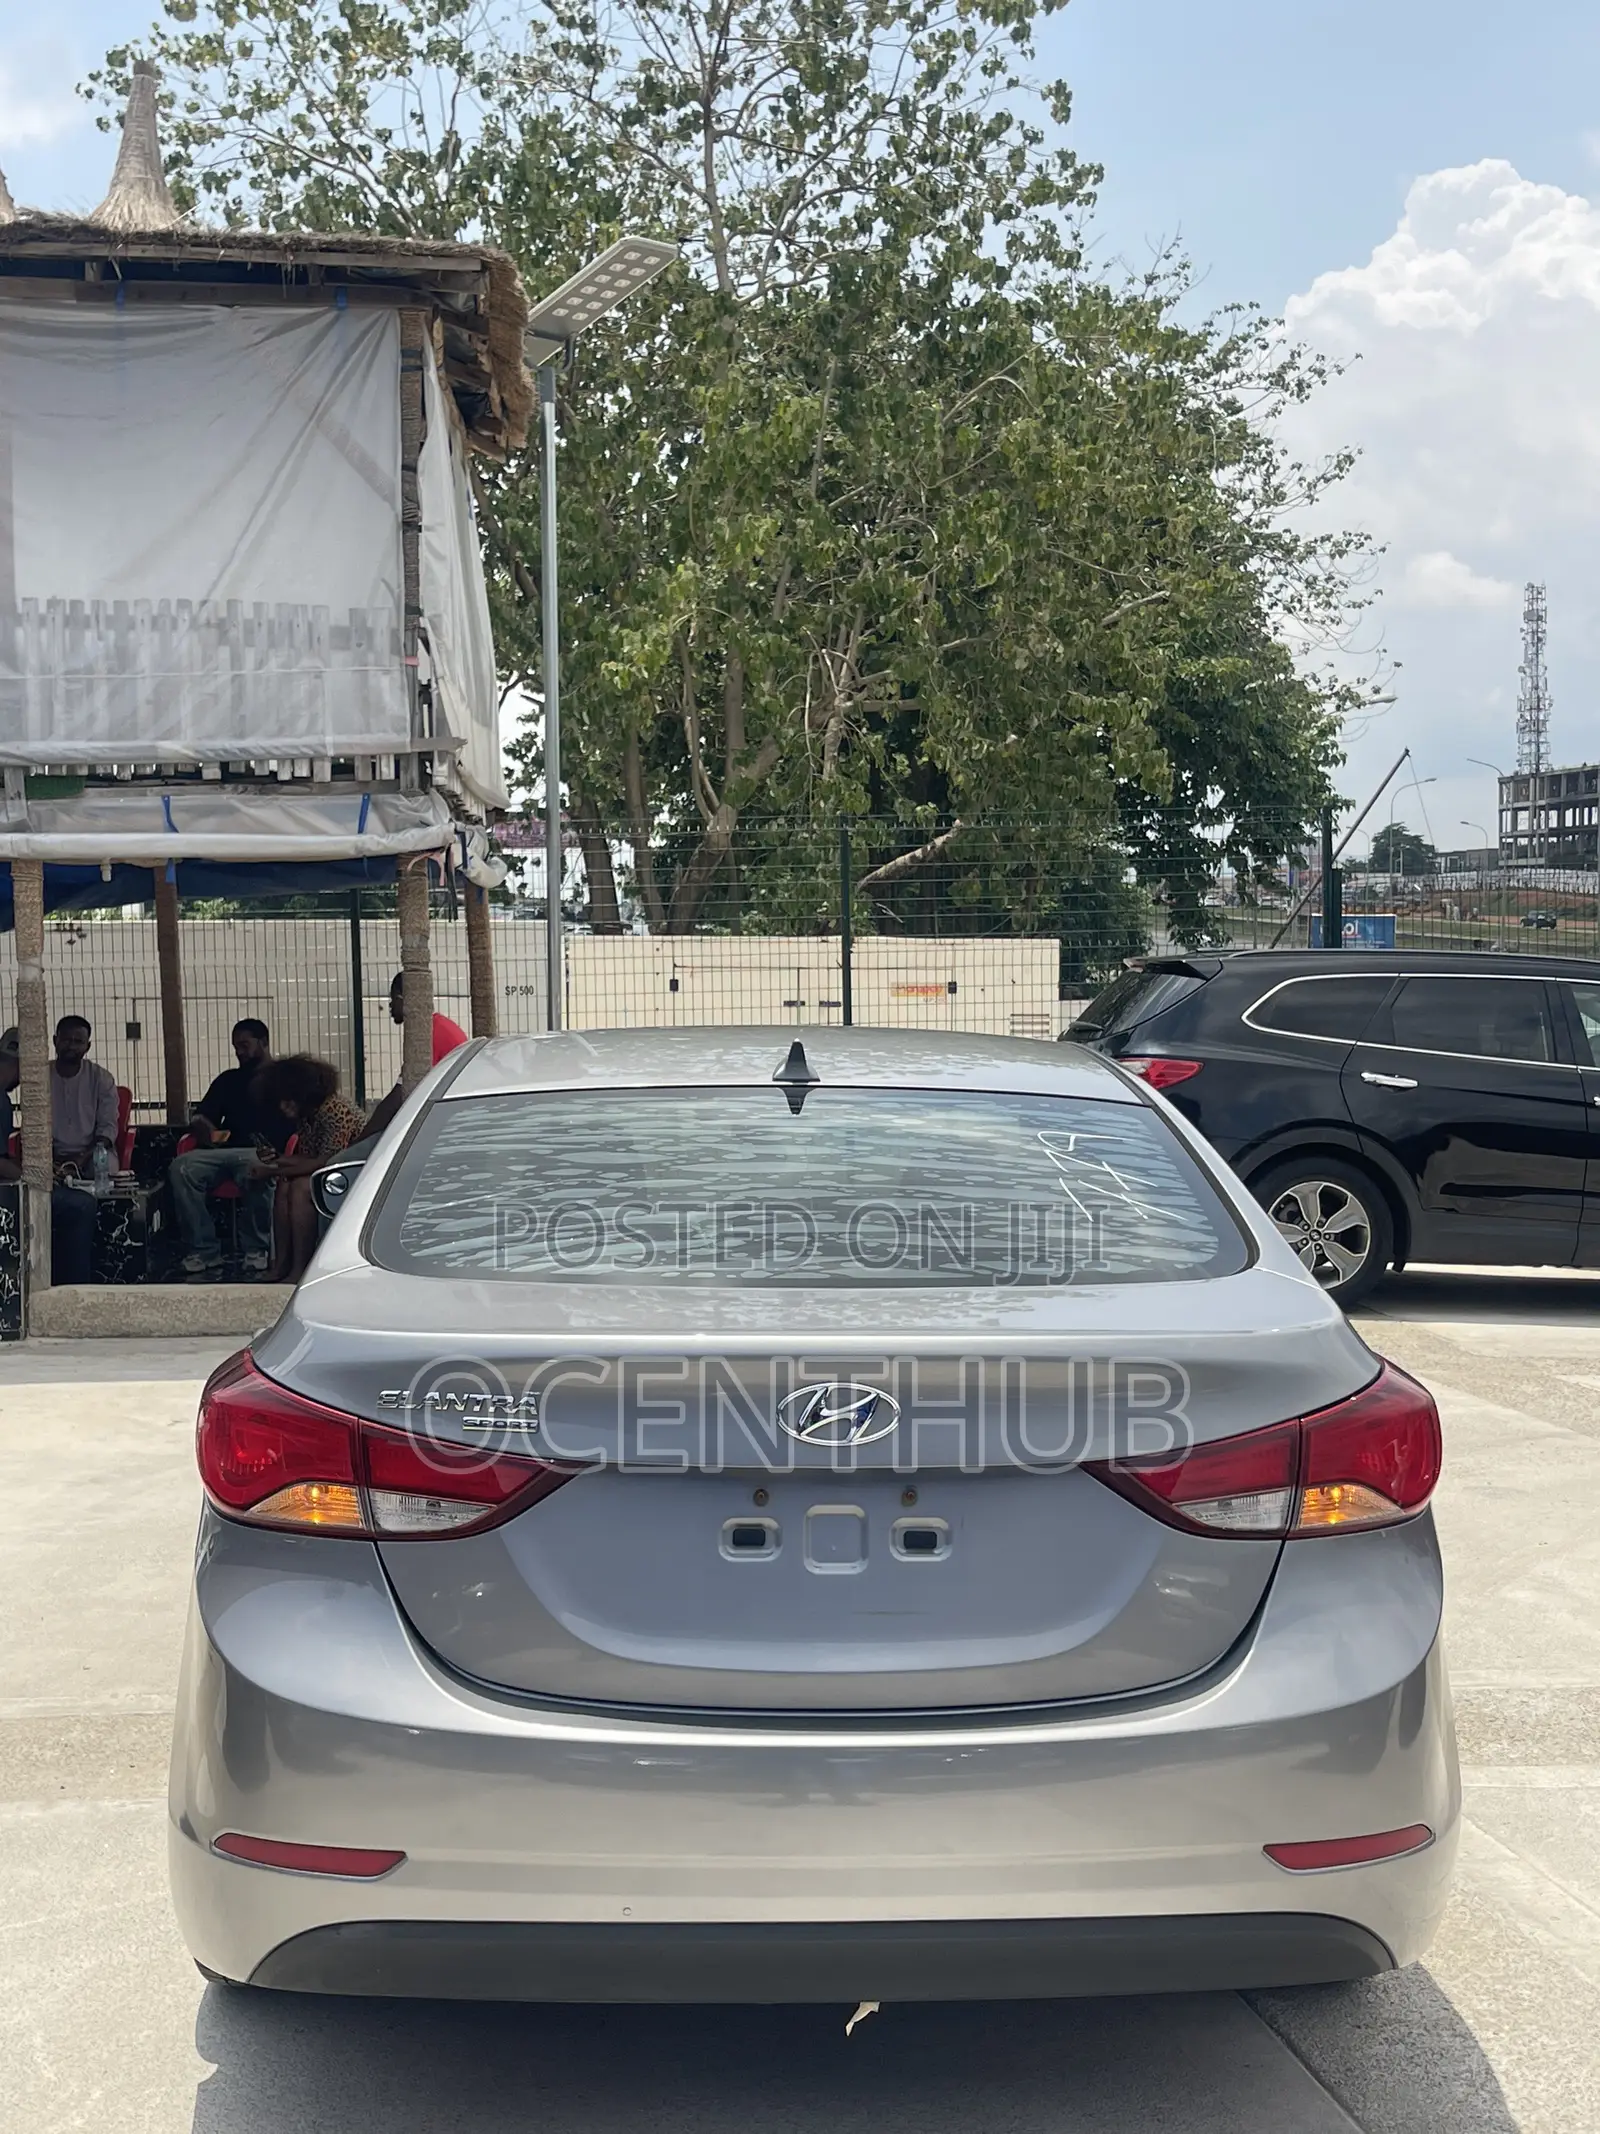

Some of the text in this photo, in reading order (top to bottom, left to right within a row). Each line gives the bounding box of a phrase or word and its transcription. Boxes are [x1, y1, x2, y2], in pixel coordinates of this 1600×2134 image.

[505, 985, 534, 996] SP 500
[376, 1389, 540, 1415] ELANTRA
[463, 1417, 539, 1432] SPORT
